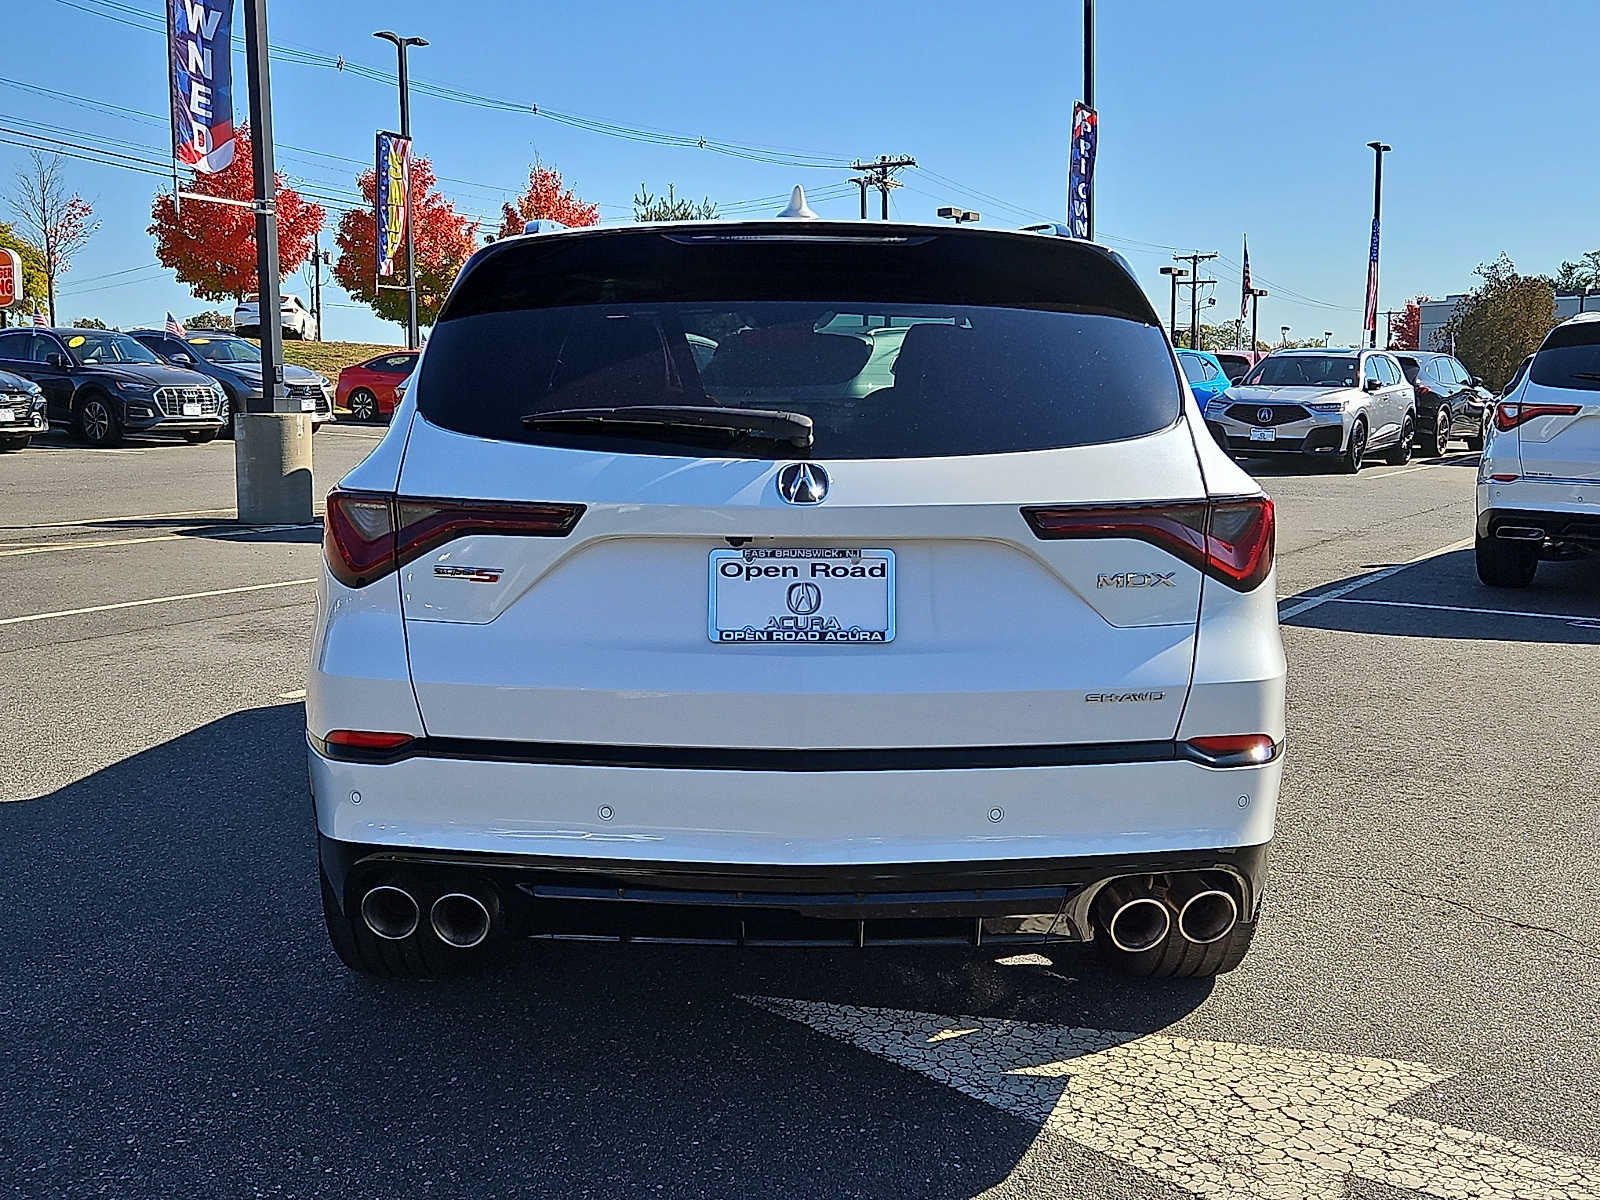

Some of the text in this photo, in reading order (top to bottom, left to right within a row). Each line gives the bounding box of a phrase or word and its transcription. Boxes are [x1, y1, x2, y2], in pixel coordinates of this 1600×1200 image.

[744, 549, 772, 558] EAST
[720, 562, 886, 581] Open Road
[1097, 573, 1176, 589] MDX
[764, 616, 841, 630] ACURA
[722, 631, 882, 641] OPEN ROAD ACURA
[1085, 692, 1166, 702] SH-AWD
